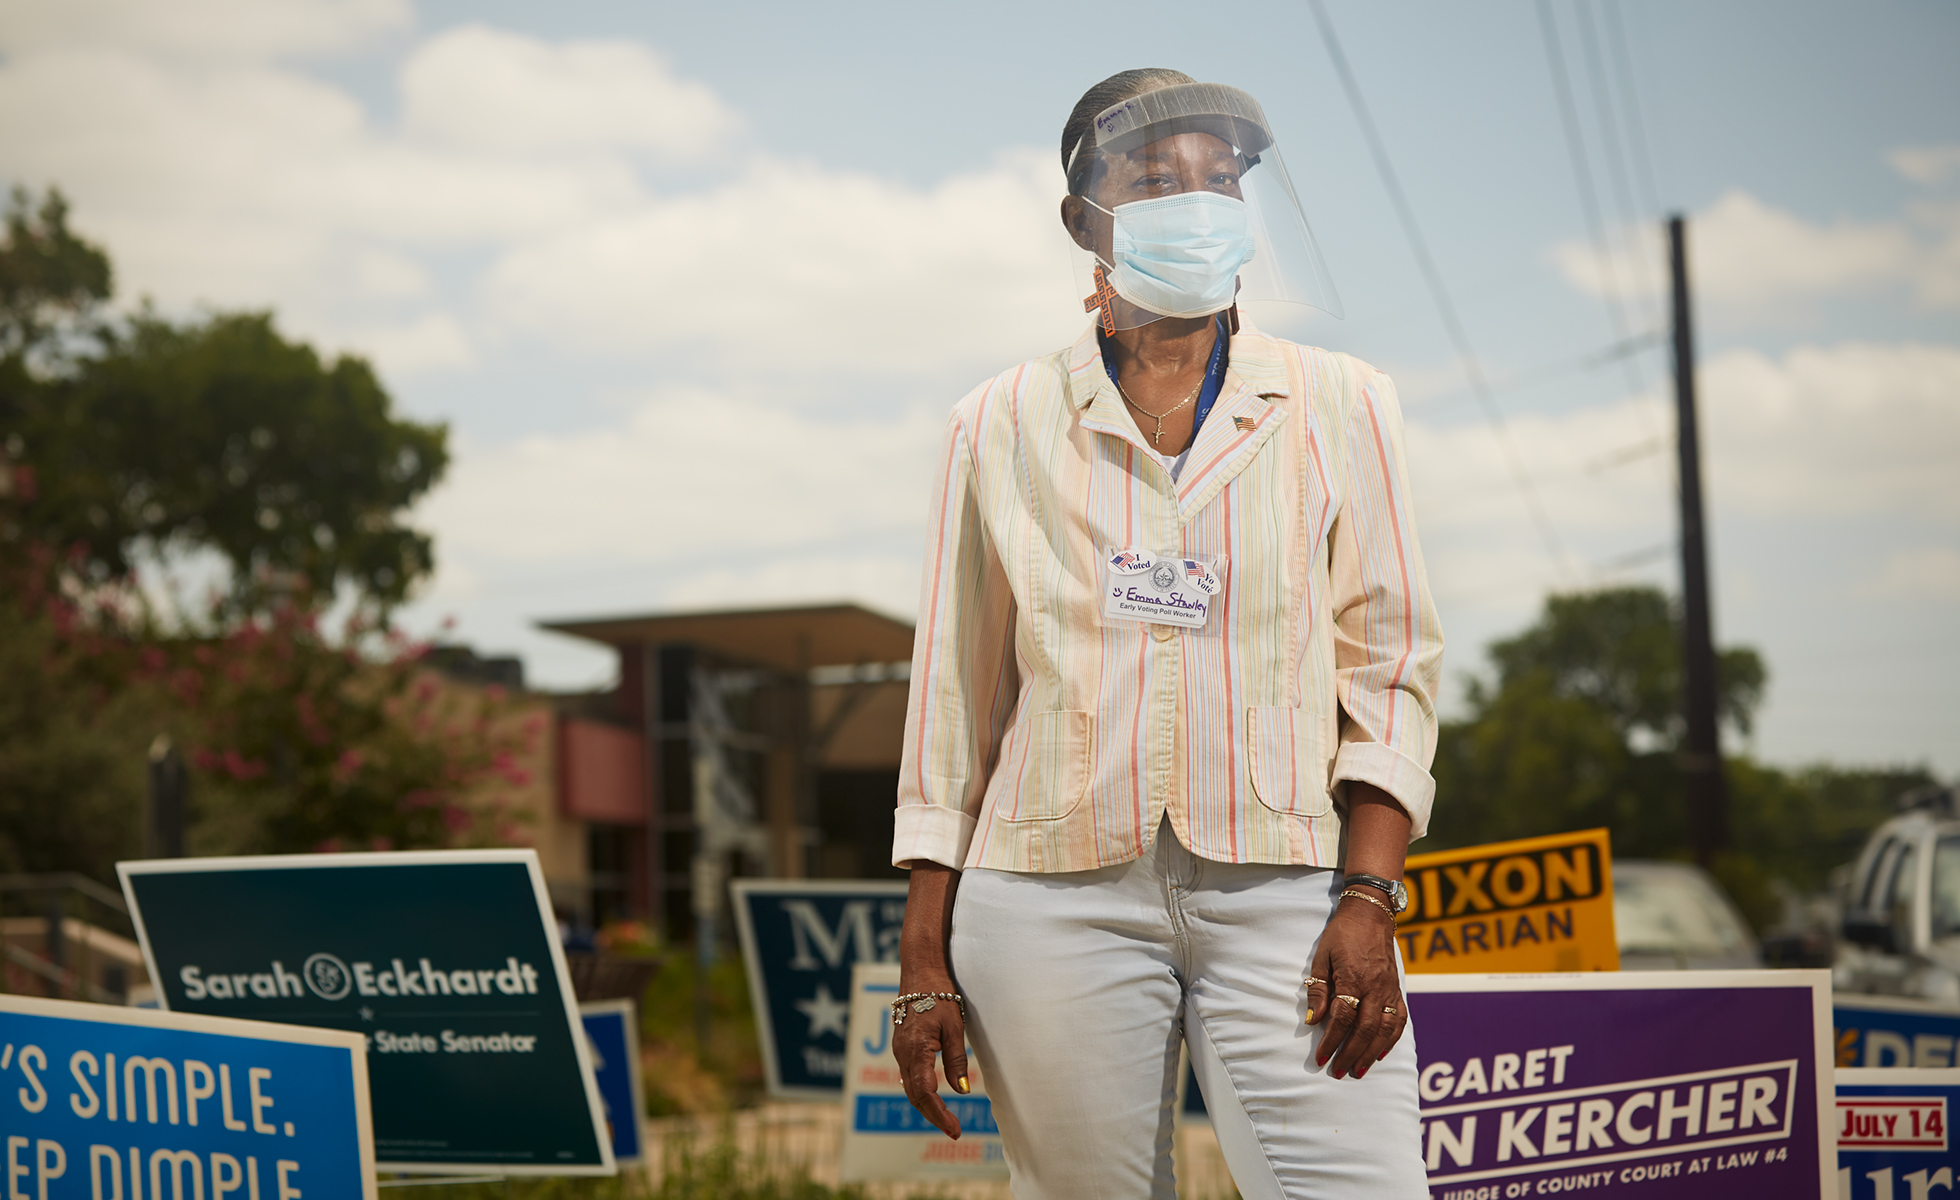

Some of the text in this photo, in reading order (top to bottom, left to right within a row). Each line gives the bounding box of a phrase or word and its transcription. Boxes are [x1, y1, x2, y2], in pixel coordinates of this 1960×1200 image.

[1127, 560, 1151, 571] Voted
[1135, 553, 1140, 561] I
[1126, 587, 1162, 604] Emma
[1196, 578, 1214, 594] Voté
[1205, 573, 1215, 585] Yo
[1119, 602, 1197, 619] Early Voting Poll Worker
[1397, 847, 1593, 924] DIXON
[1400, 907, 1574, 963] TARIAN
[180, 960, 304, 1000] Sarah
[352, 957, 539, 996] Eckhardt
[374, 1030, 438, 1053] State
[440, 1030, 537, 1053] Senator
[1864, 1029, 1960, 1068] DE
[1419, 1044, 1575, 1102] GARET
[69, 1050, 295, 1137] SIMPLE.
[1420, 1076, 1779, 1171] N KERCHER
[1841, 1109, 1944, 1138] JULY 14
[0, 1135, 67, 1200] EP
[1505, 1180, 1531, 1199] OF
[1536, 1170, 1615, 1195] COUNTY
[1620, 1161, 1683, 1184] COURT
[1687, 1157, 1712, 1175] AT
[1717, 1151, 1759, 1171] LAW
[1764, 1146, 1788, 1164] #4
